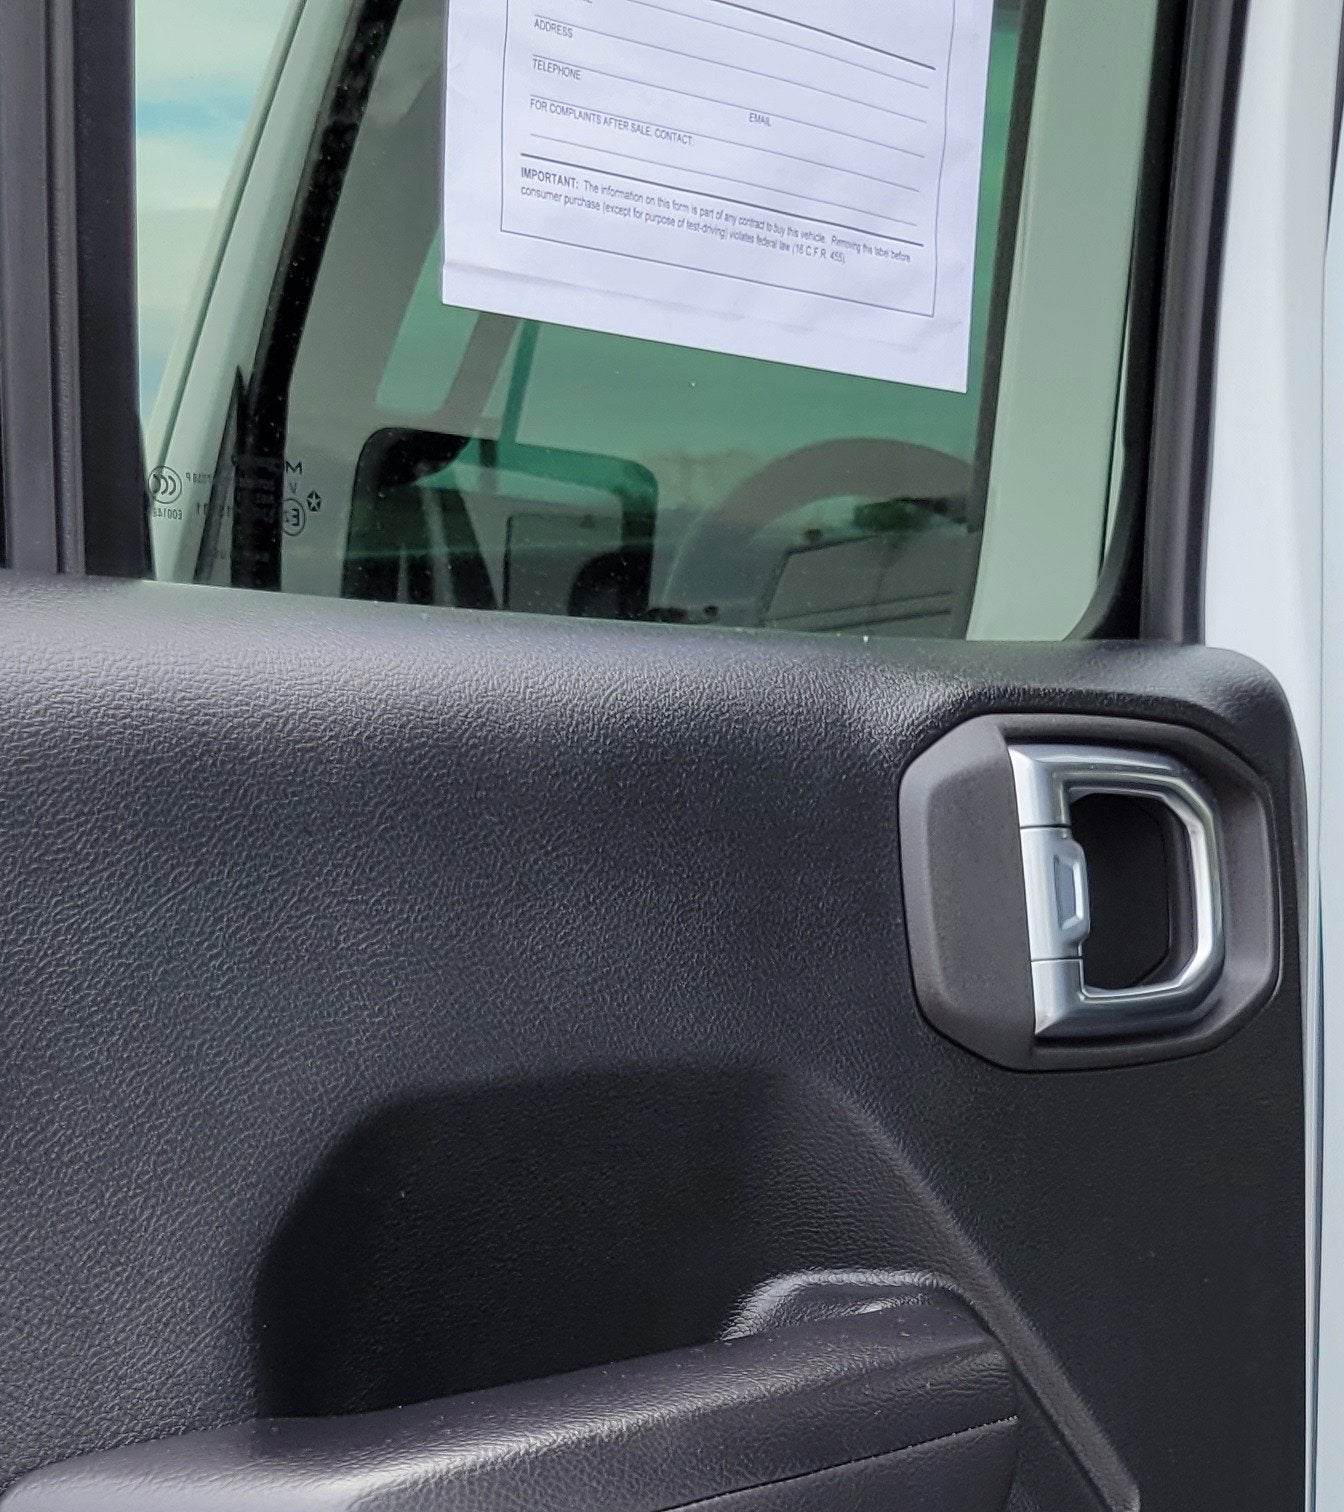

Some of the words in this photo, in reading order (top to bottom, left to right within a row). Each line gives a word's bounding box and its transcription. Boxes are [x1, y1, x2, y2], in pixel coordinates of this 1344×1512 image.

[534, 18, 573, 38] ADDRESS
[533, 58, 581, 80] TELEPHONE
[530, 98, 547, 111] FOR
[549, 104, 601, 125] COMPLAINTS
[603, 117, 629, 131] AFTER
[749, 113, 771, 127] EMAIL
[521, 167, 579, 189] IMPORTANT:
[584, 180, 599, 194] The
[601, 183, 643, 203] information
[645, 194, 655, 205] on
[657, 196, 670, 210] this
[672, 199, 689, 214] form
[691, 205, 698, 215] is
[699, 206, 714, 221] part
[715, 210, 724, 221] of
[725, 212, 738, 227] any
[738, 216, 766, 231] contract
[831, 234, 860, 254] Removing
[891, 249, 911, 263] before
[521, 186, 562, 204] consumer
[564, 194, 600, 212] purchase
[603, 202, 631, 218] (except
[633, 207, 644, 219] for
[645, 210, 675, 229] purpose
[677, 215, 685, 228] of
[730, 230, 754, 245] violates
[756, 235, 778, 250] federal
